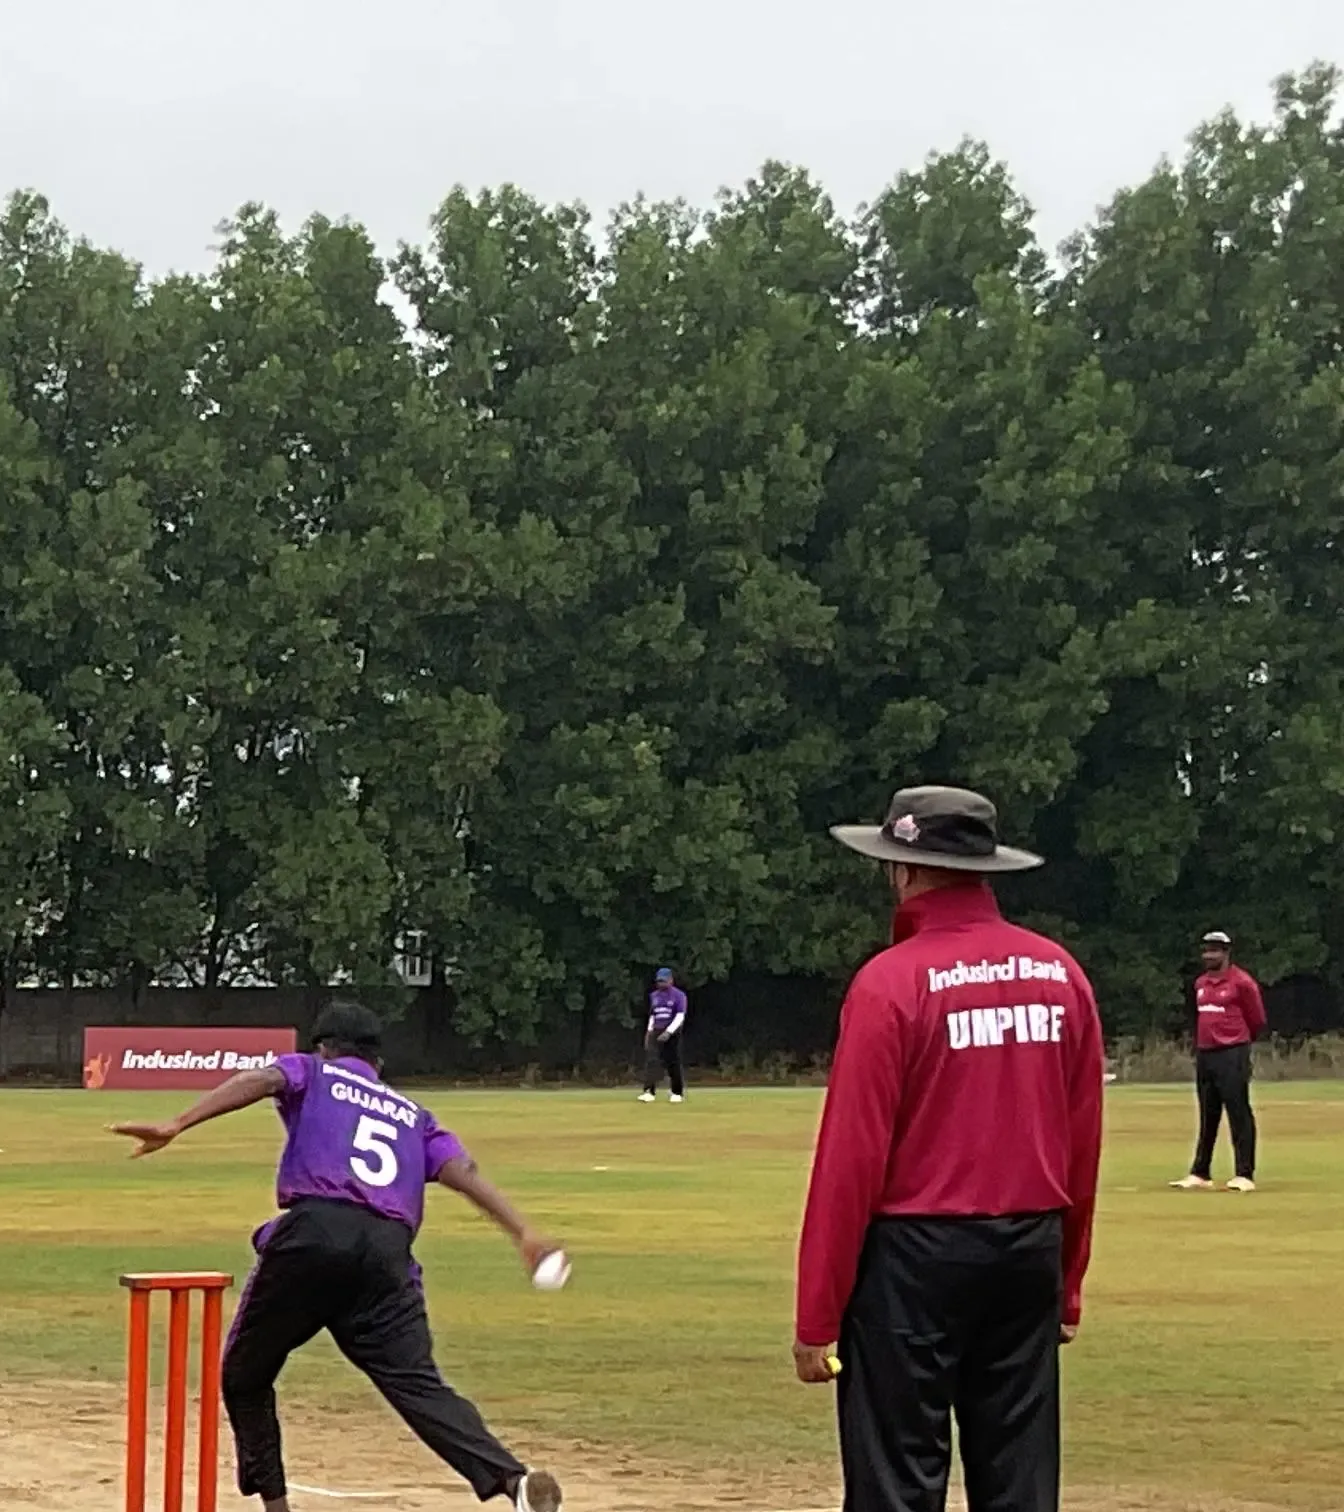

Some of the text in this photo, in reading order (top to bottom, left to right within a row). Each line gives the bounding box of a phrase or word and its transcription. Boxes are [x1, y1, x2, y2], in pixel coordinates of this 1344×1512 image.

[927, 956, 1068, 992] IndusInd Bank
[947, 1003, 1066, 1050] UMPIRE
[122, 1049, 278, 1070] IndusInd Bank
[330, 1081, 418, 1128] GUJARAT
[349, 1114, 399, 1187] 5
